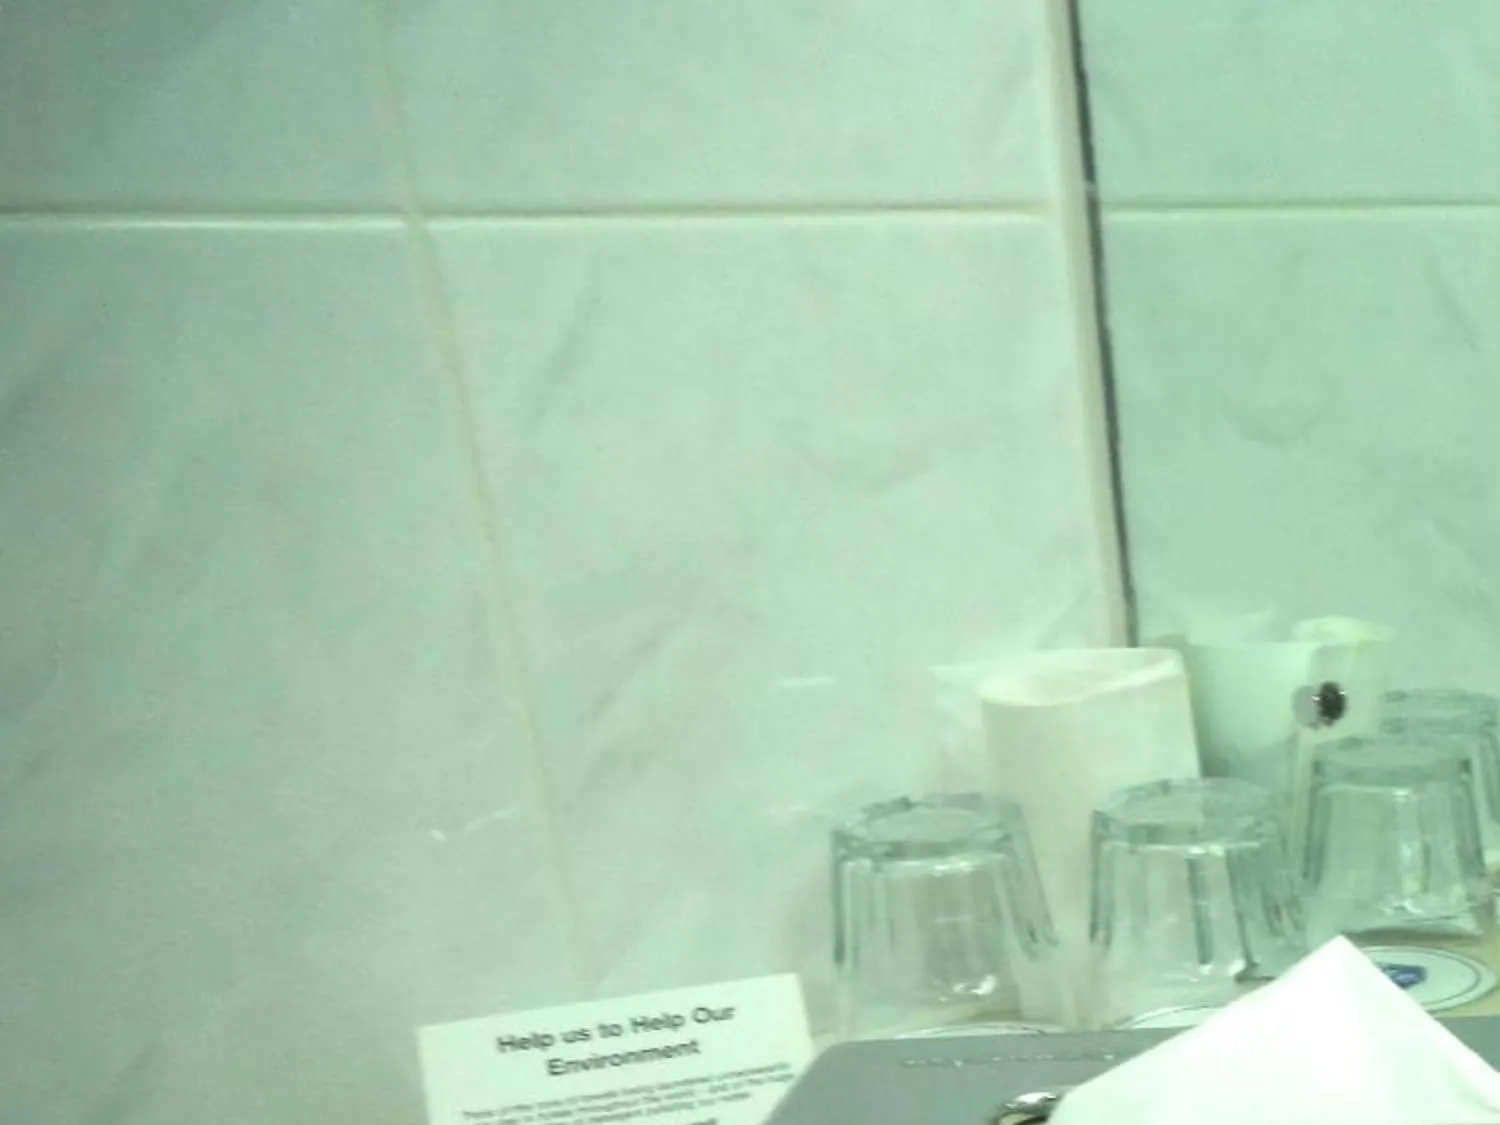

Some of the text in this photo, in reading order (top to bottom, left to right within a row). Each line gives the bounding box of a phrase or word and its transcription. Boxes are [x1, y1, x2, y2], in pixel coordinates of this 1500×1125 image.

[496, 1006, 736, 1053] Help us to Help Our
[546, 1039, 701, 1076] Environment
